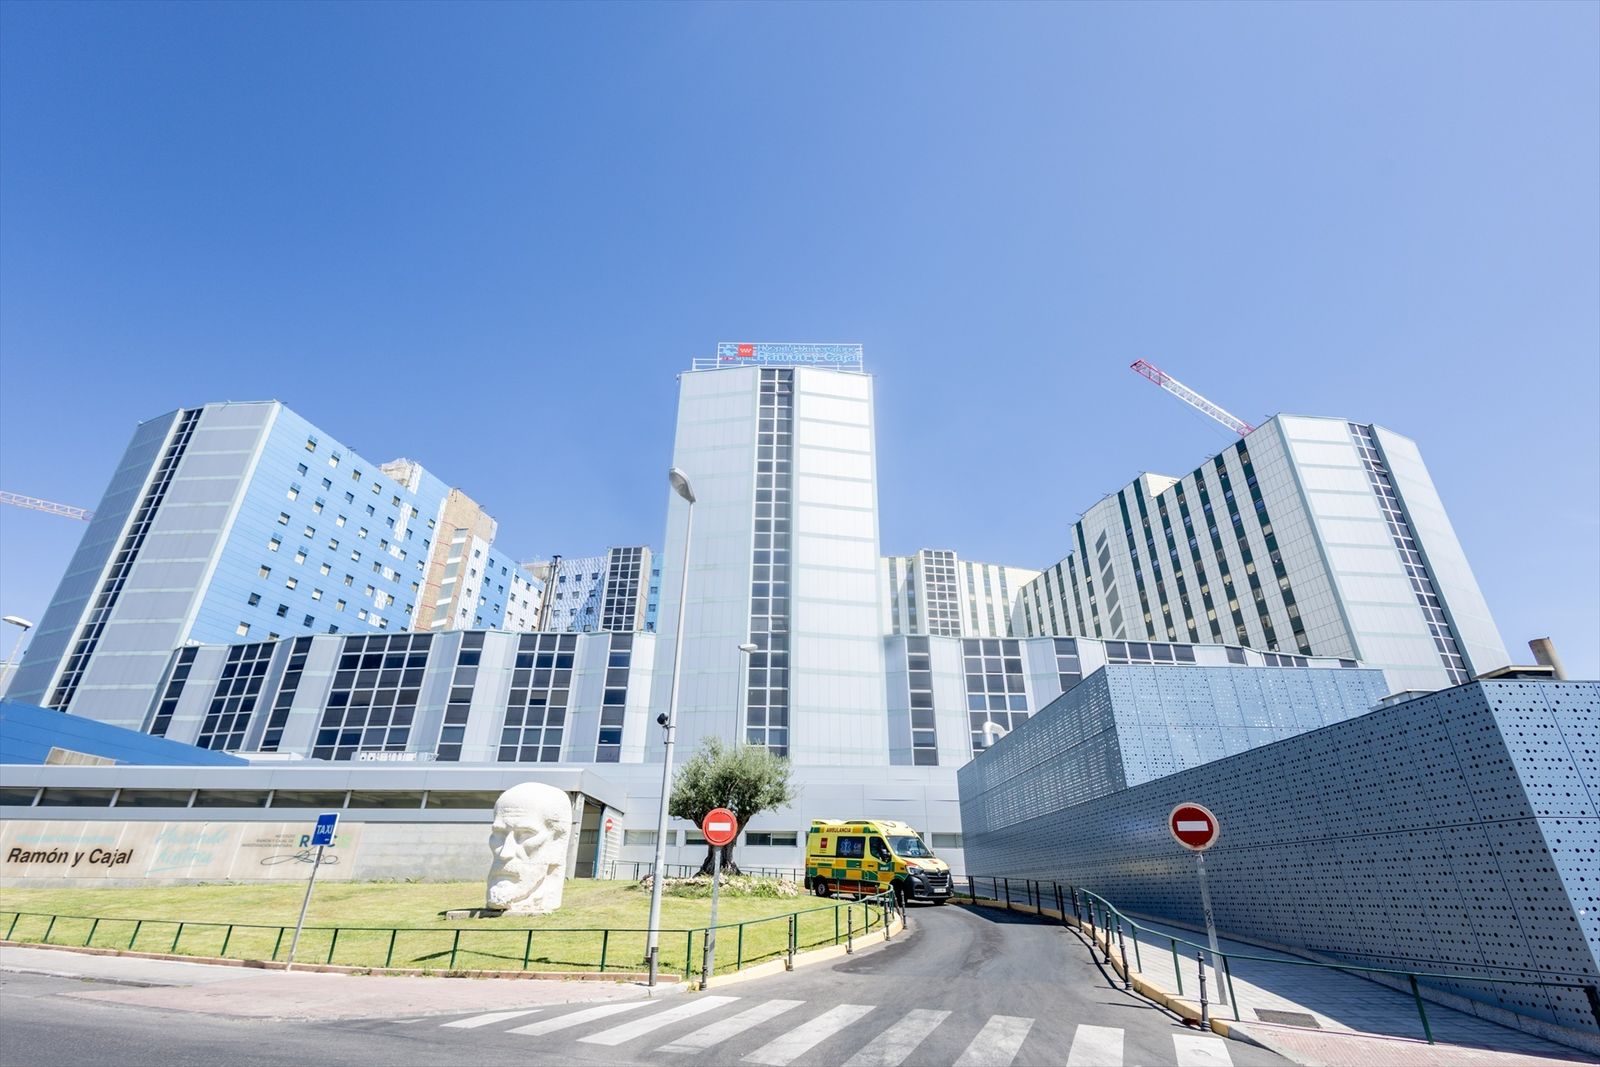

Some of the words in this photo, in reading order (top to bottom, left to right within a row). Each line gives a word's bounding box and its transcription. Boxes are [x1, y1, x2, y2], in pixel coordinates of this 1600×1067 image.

[317, 825, 333, 835] TAXI
[7, 848, 68, 863] Ramón
[71, 851, 84, 868] y
[88, 848, 133, 868] Cajal
